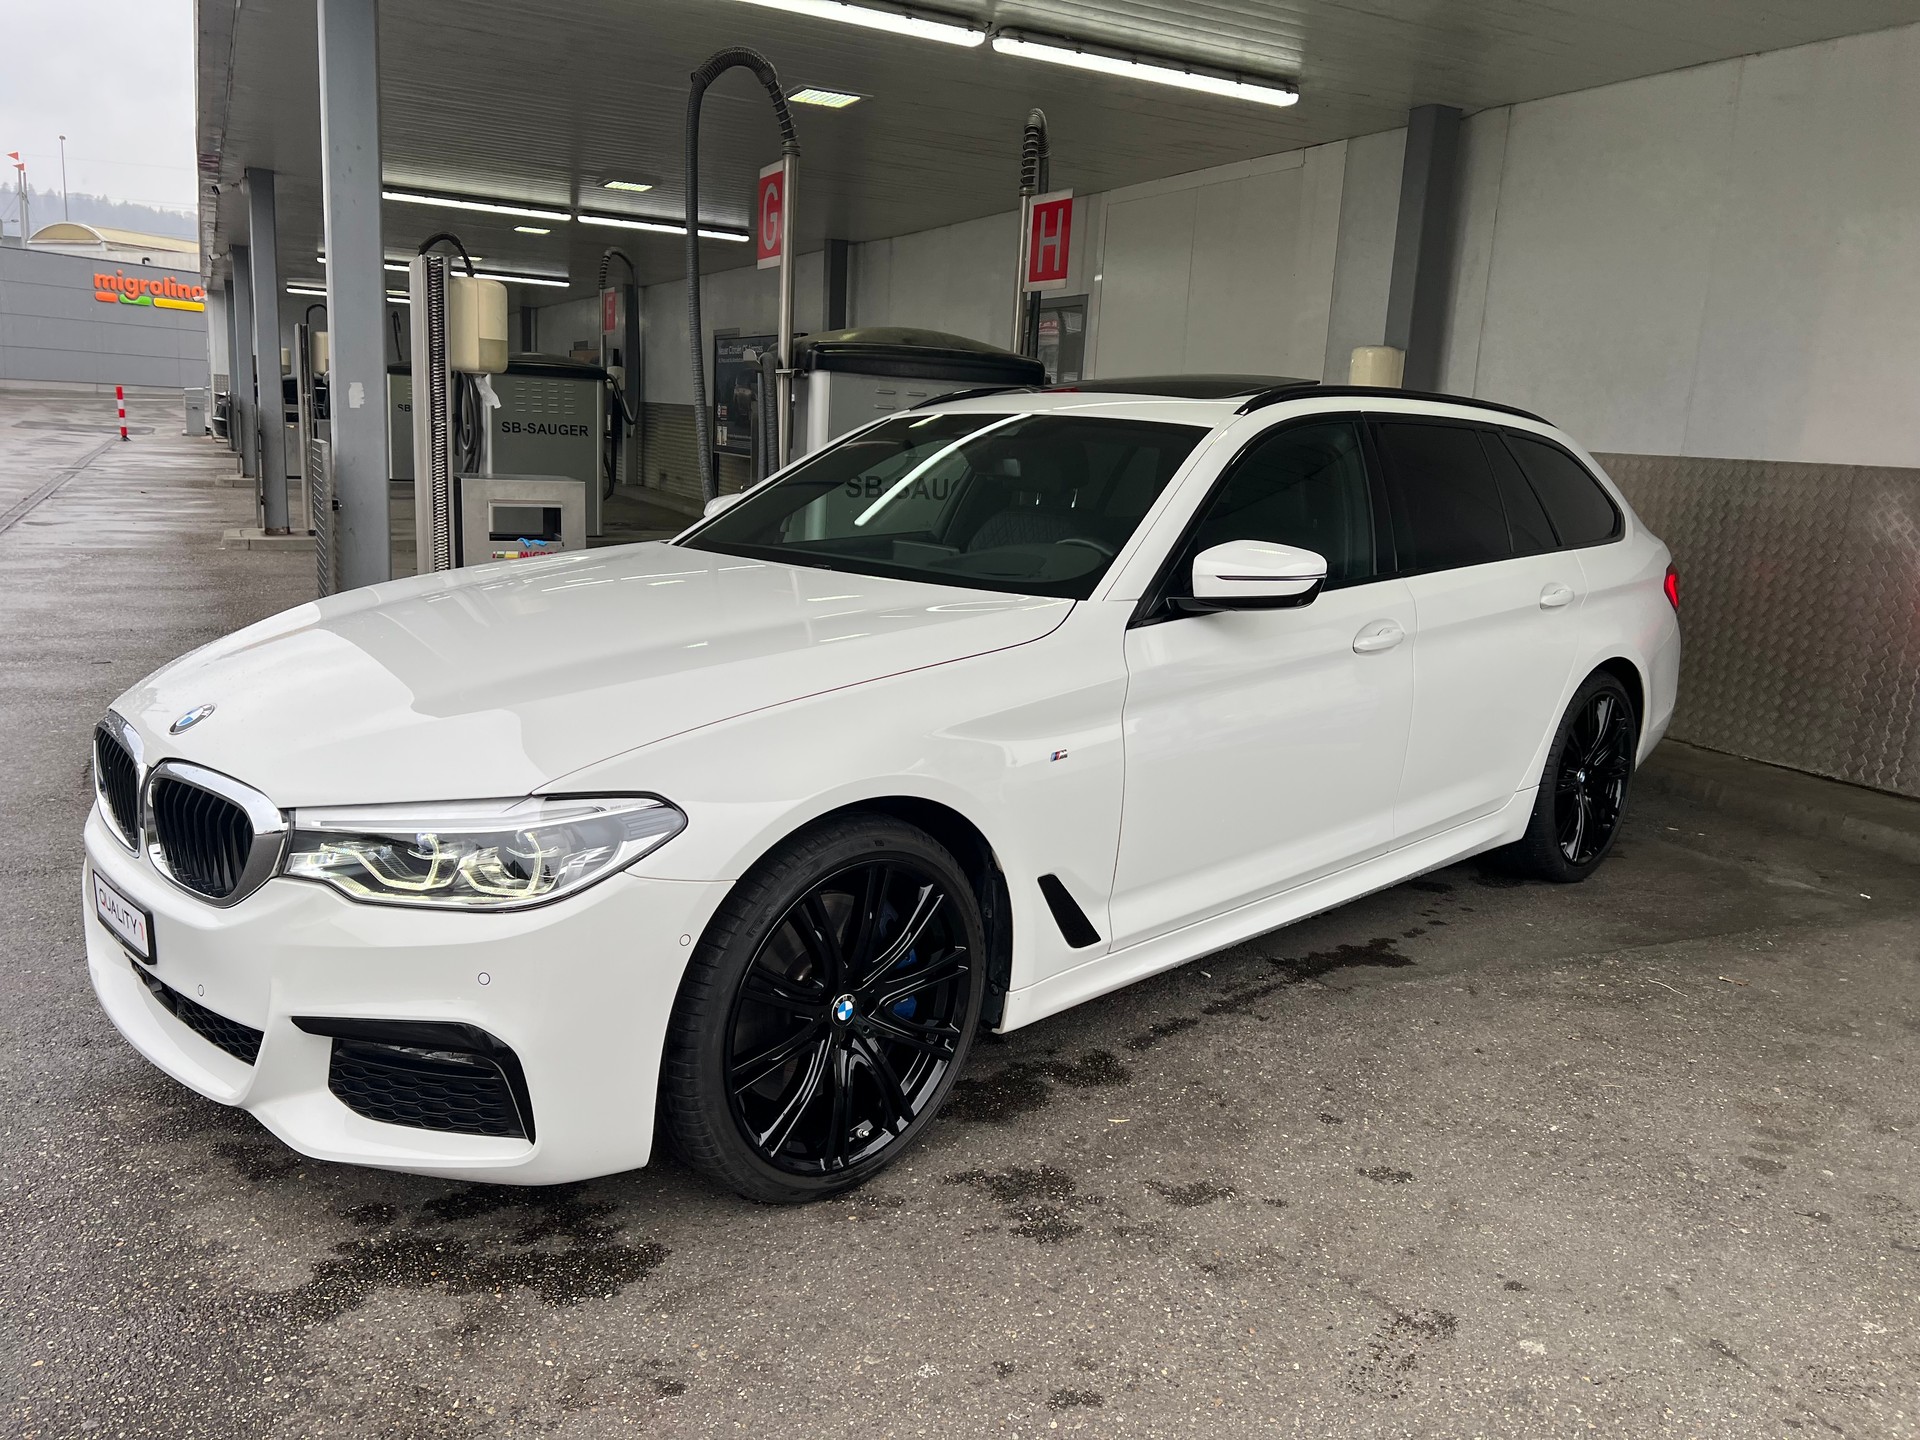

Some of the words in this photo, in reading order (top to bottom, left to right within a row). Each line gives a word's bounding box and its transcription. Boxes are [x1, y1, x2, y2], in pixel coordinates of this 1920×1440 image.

[763, 182, 778, 251] G
[1037, 207, 1064, 273] H
[94, 269, 205, 300] migrolino
[502, 421, 589, 436] SB-SAUGER
